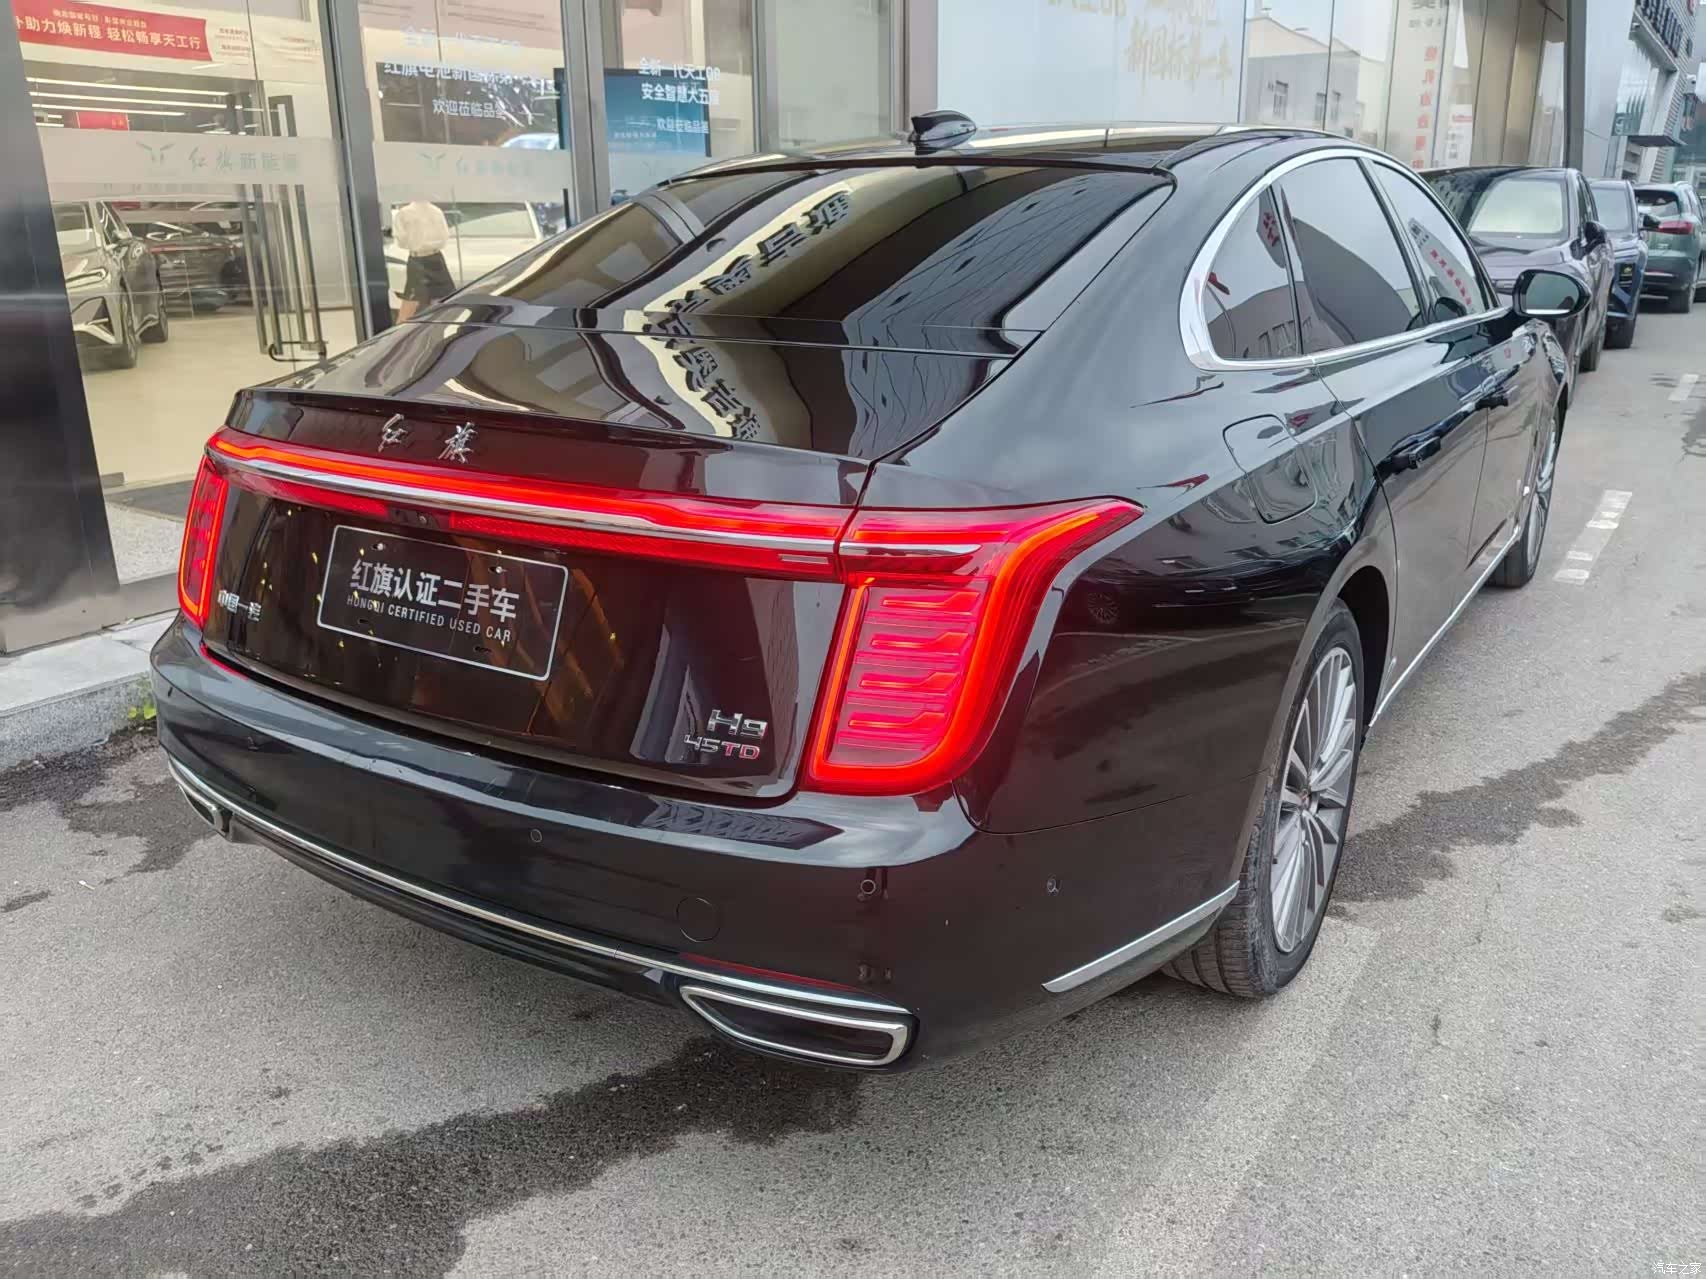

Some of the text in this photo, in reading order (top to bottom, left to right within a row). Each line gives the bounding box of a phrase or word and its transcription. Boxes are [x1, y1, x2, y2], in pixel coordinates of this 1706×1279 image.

[349, 558, 520, 623] 红旗认证二手车
[347, 594, 512, 642] HONGQI CERTIFIED USED CAR
[706, 708, 768, 737] H9
[683, 734, 761, 760] 45TD
